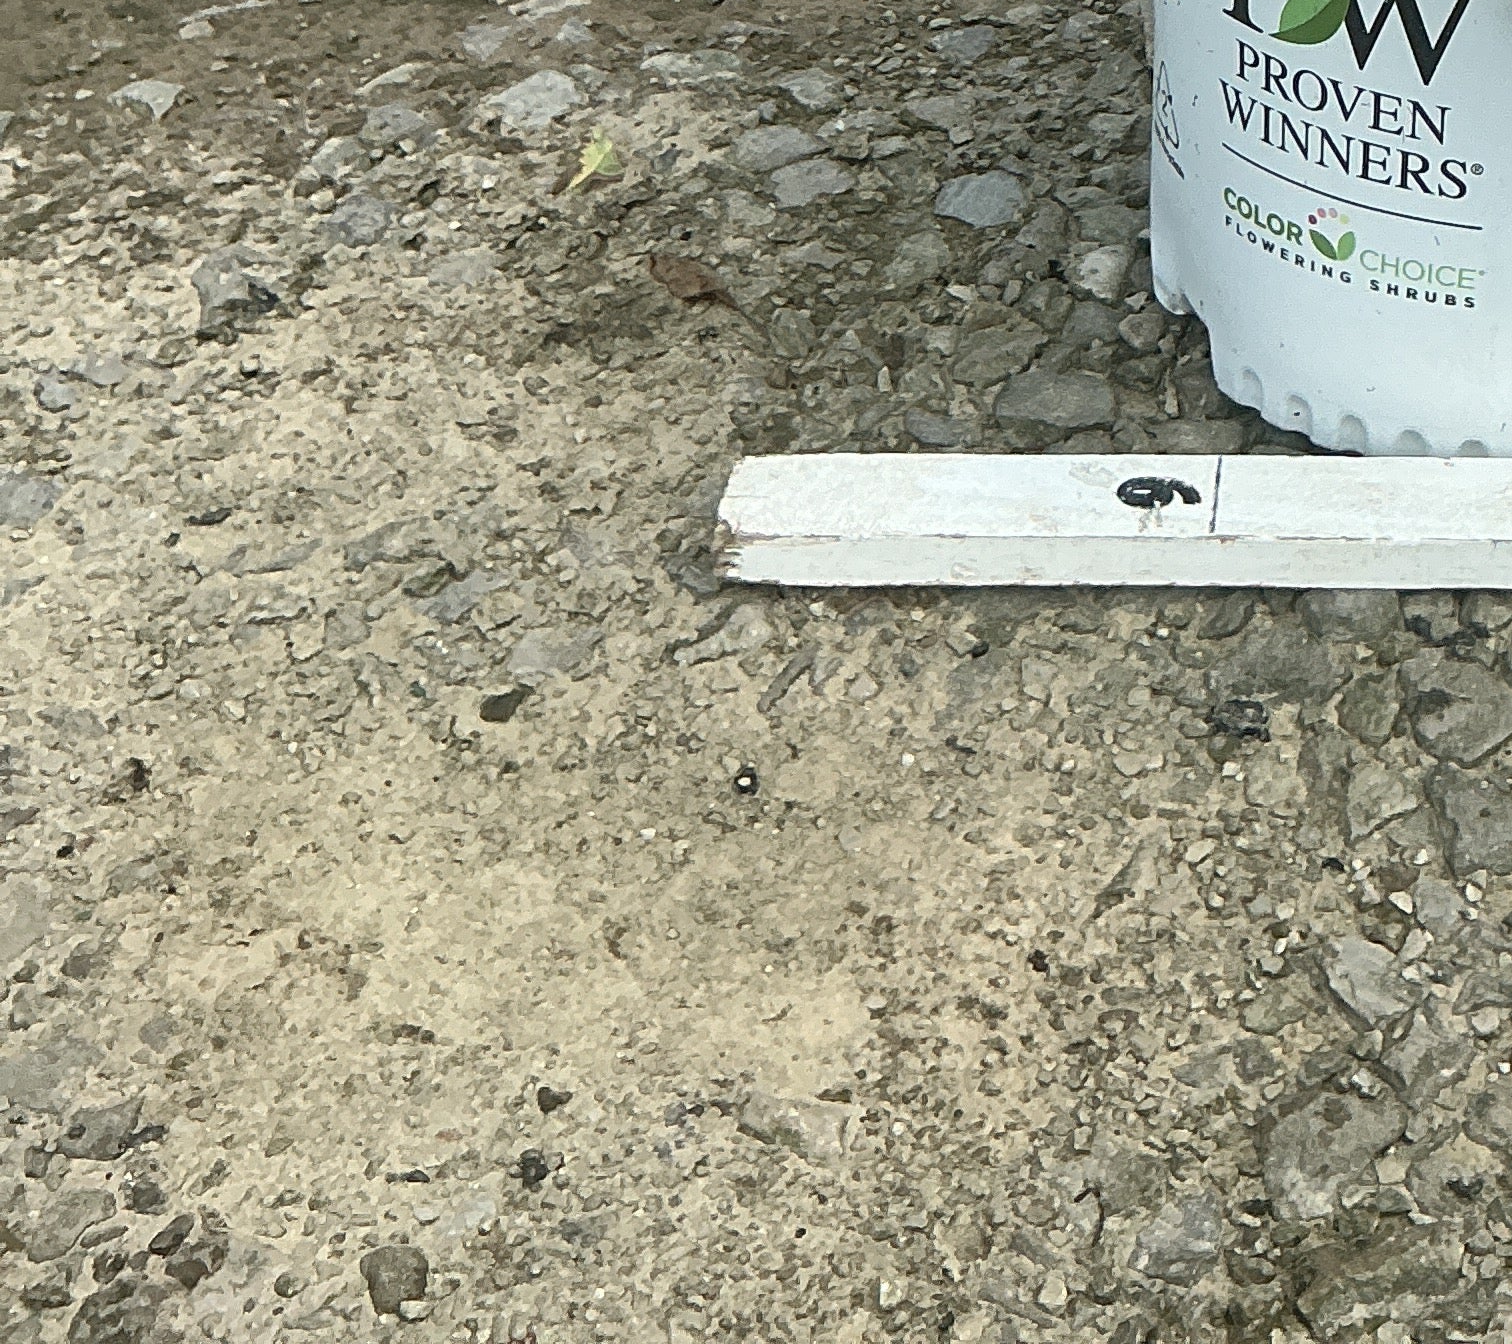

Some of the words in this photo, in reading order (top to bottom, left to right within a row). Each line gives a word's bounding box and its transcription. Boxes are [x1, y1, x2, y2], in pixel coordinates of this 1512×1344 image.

[1235, 38, 1452, 145] PROVEN
[1223, 187, 1304, 246] COLOR
[1225, 215, 1352, 284] FLOWERING
[1369, 279, 1476, 309] SHRUBS
